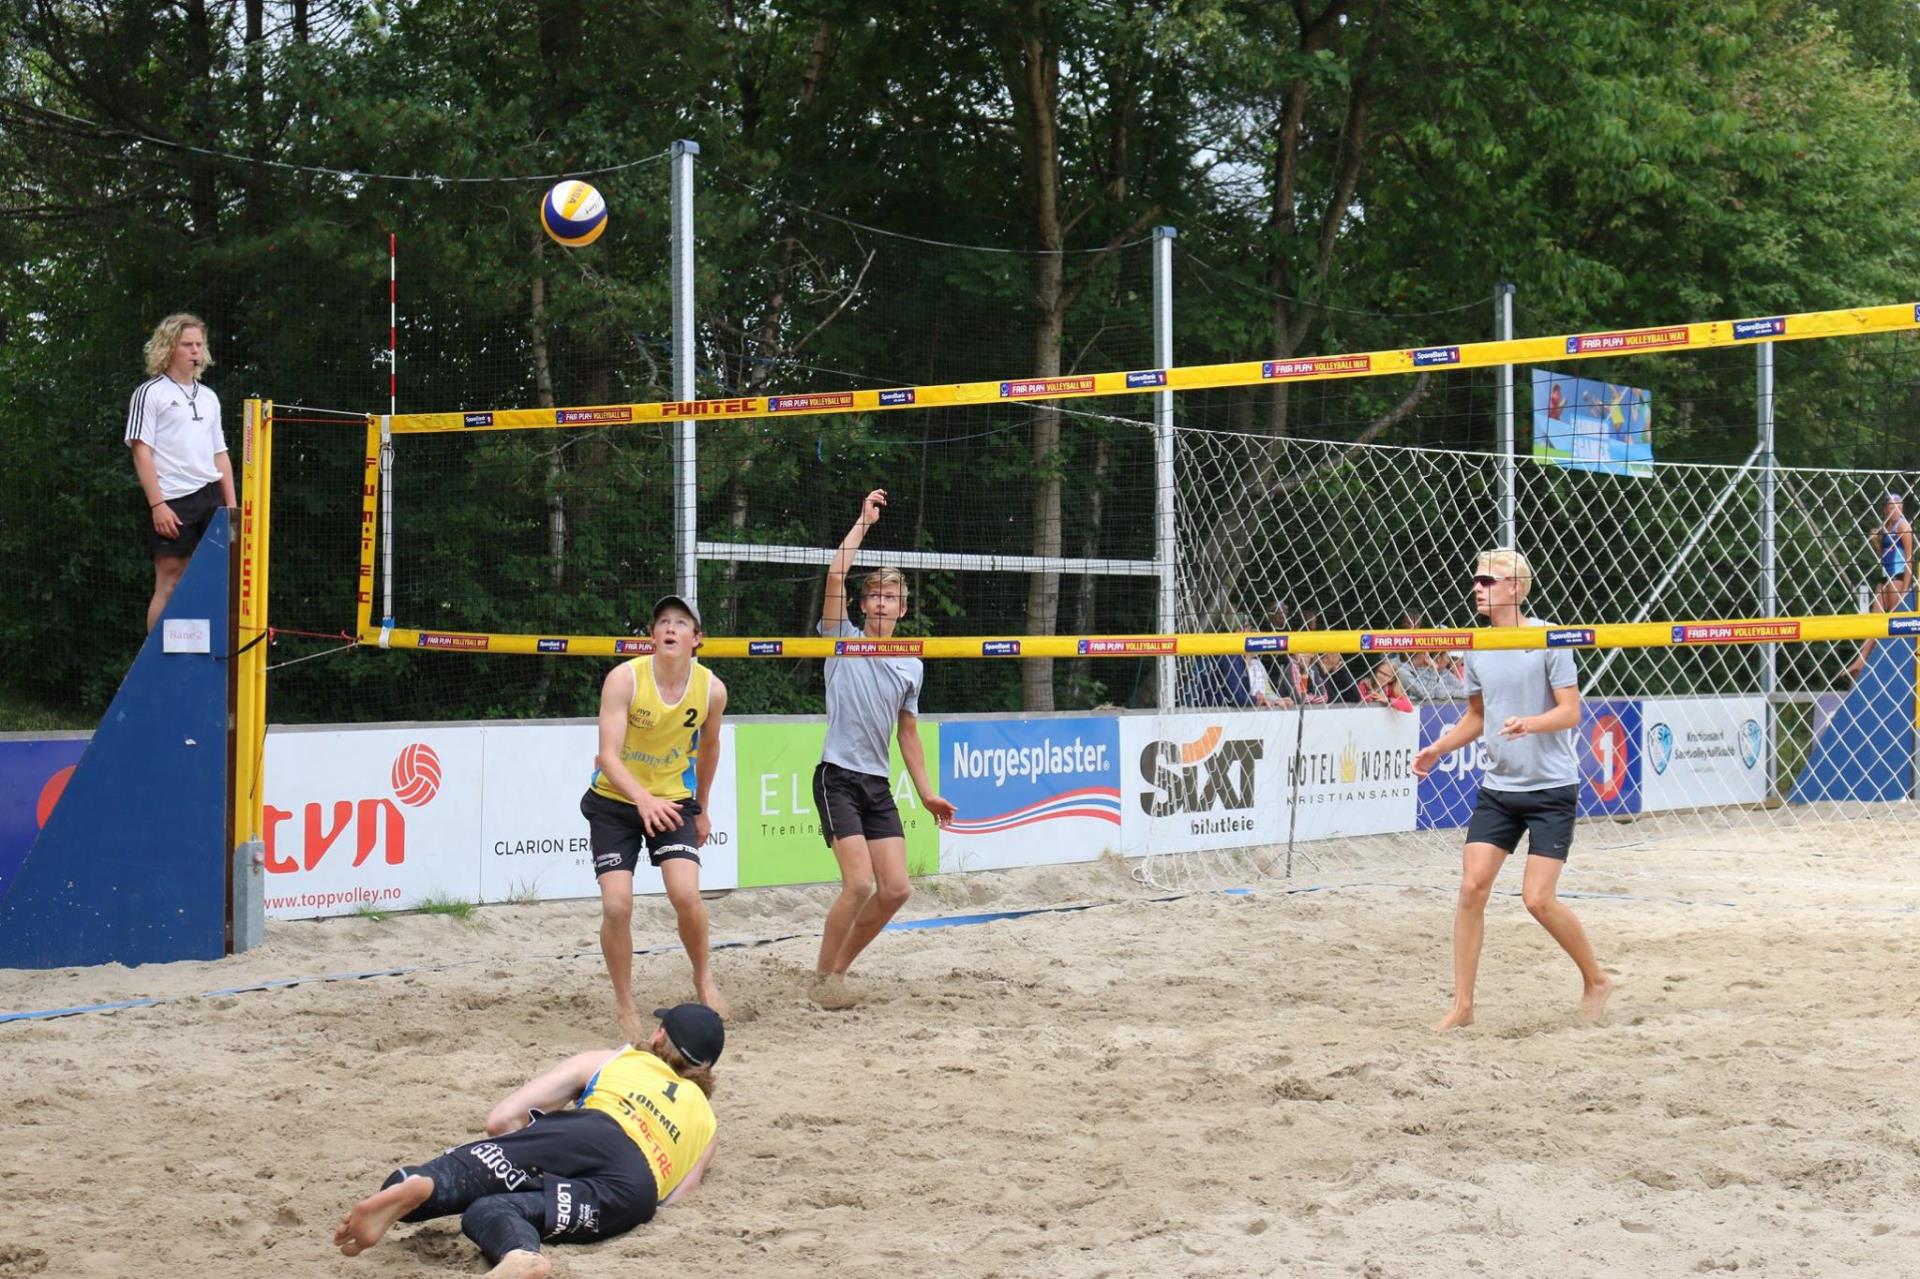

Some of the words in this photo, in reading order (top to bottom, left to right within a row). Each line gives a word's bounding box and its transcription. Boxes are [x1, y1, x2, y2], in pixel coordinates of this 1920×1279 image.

[1582, 338, 1601, 349] FAIR
[1603, 337, 1624, 347] PLAY
[1625, 334, 1669, 345] VOLLEYBALL
[1669, 331, 1686, 341] WAY
[1275, 364, 1293, 374] FAIR
[1294, 363, 1312, 373] PLAY
[1313, 361, 1353, 371] VOLLEYBALL
[1353, 359, 1368, 368] WAY
[1012, 385, 1028, 394] FAIR
[1028, 384, 1045, 392] PLAY
[1046, 382, 1080, 391] VOLLEYBALL
[1080, 380, 1093, 389] WAY
[662, 398, 757, 416] FUNTEC
[779, 400, 793, 408] FAIR
[793, 399, 809, 407] PLAY
[809, 396, 840, 406] VOLLEYBALL
[840, 396, 852, 404] WAY
[242, 500, 253, 617] FUNTEC
[1374, 637, 1392, 646] FAIR
[1394, 637, 1413, 646] PLAY
[1415, 636, 1455, 646] VOLLEYBALL
[1455, 636, 1470, 645] WAY
[1687, 628, 1708, 639] FAIR
[1709, 628, 1732, 638] PLAY
[1733, 626, 1778, 637] VOLLEYBALL
[1780, 625, 1797, 635] WAY
[846, 644, 861, 652] FAIR
[862, 644, 877, 652] PLAY
[877, 643, 909, 652] VOLLEYBALL
[910, 643, 921, 652] WAY
[1090, 643, 1106, 651] FAIR
[1107, 642, 1124, 651] PLAY
[1125, 642, 1160, 650] VOLLEYBALL
[1161, 642, 1174, 650] WAY
[683, 708, 698, 728] 2
[1287, 752, 1336, 788] HOTEL
[1360, 749, 1412, 781] NORGE
[1599, 730, 1613, 790] 1
[1287, 787, 1411, 806] KRISTIANSAND
[1190, 816, 1255, 836] bilutleie
[494, 839, 564, 857] CLARION
[661, 1080, 680, 1104] 1
